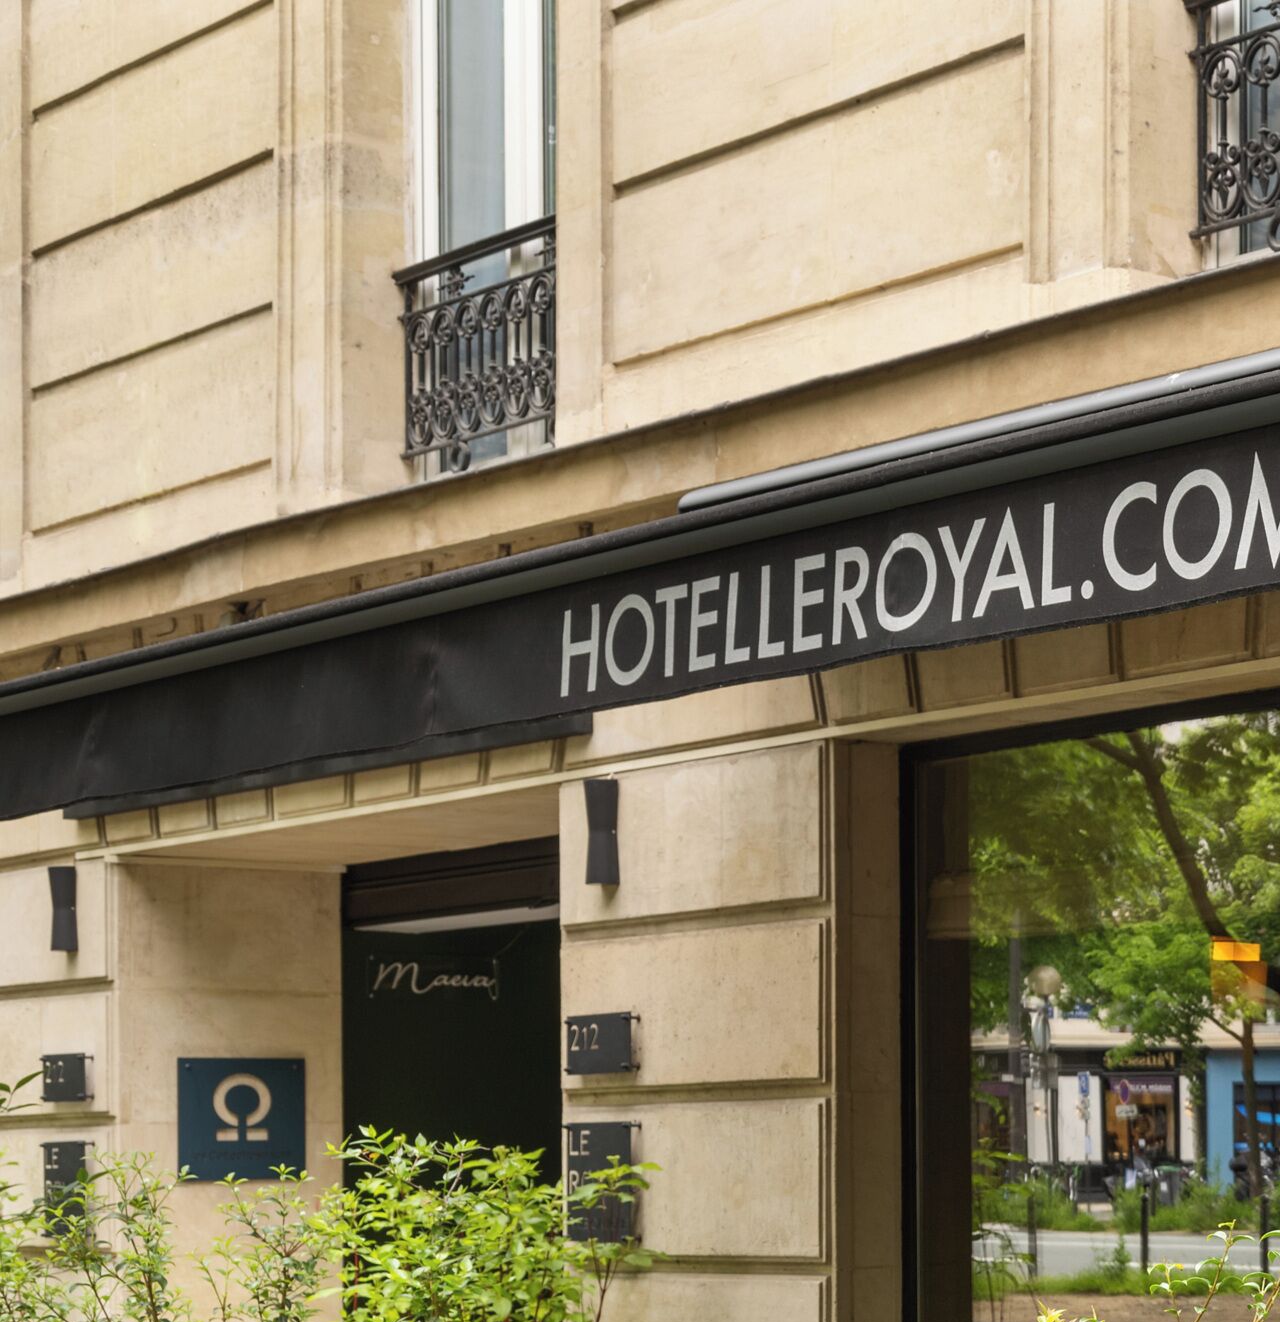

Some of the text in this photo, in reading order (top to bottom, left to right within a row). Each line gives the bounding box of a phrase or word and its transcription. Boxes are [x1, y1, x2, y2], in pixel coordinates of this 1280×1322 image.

[373, 962, 496, 994] Maeva
[570, 1023, 599, 1052] 212
[569, 1129, 591, 1156] LE
[45, 1147, 60, 1170] LE
